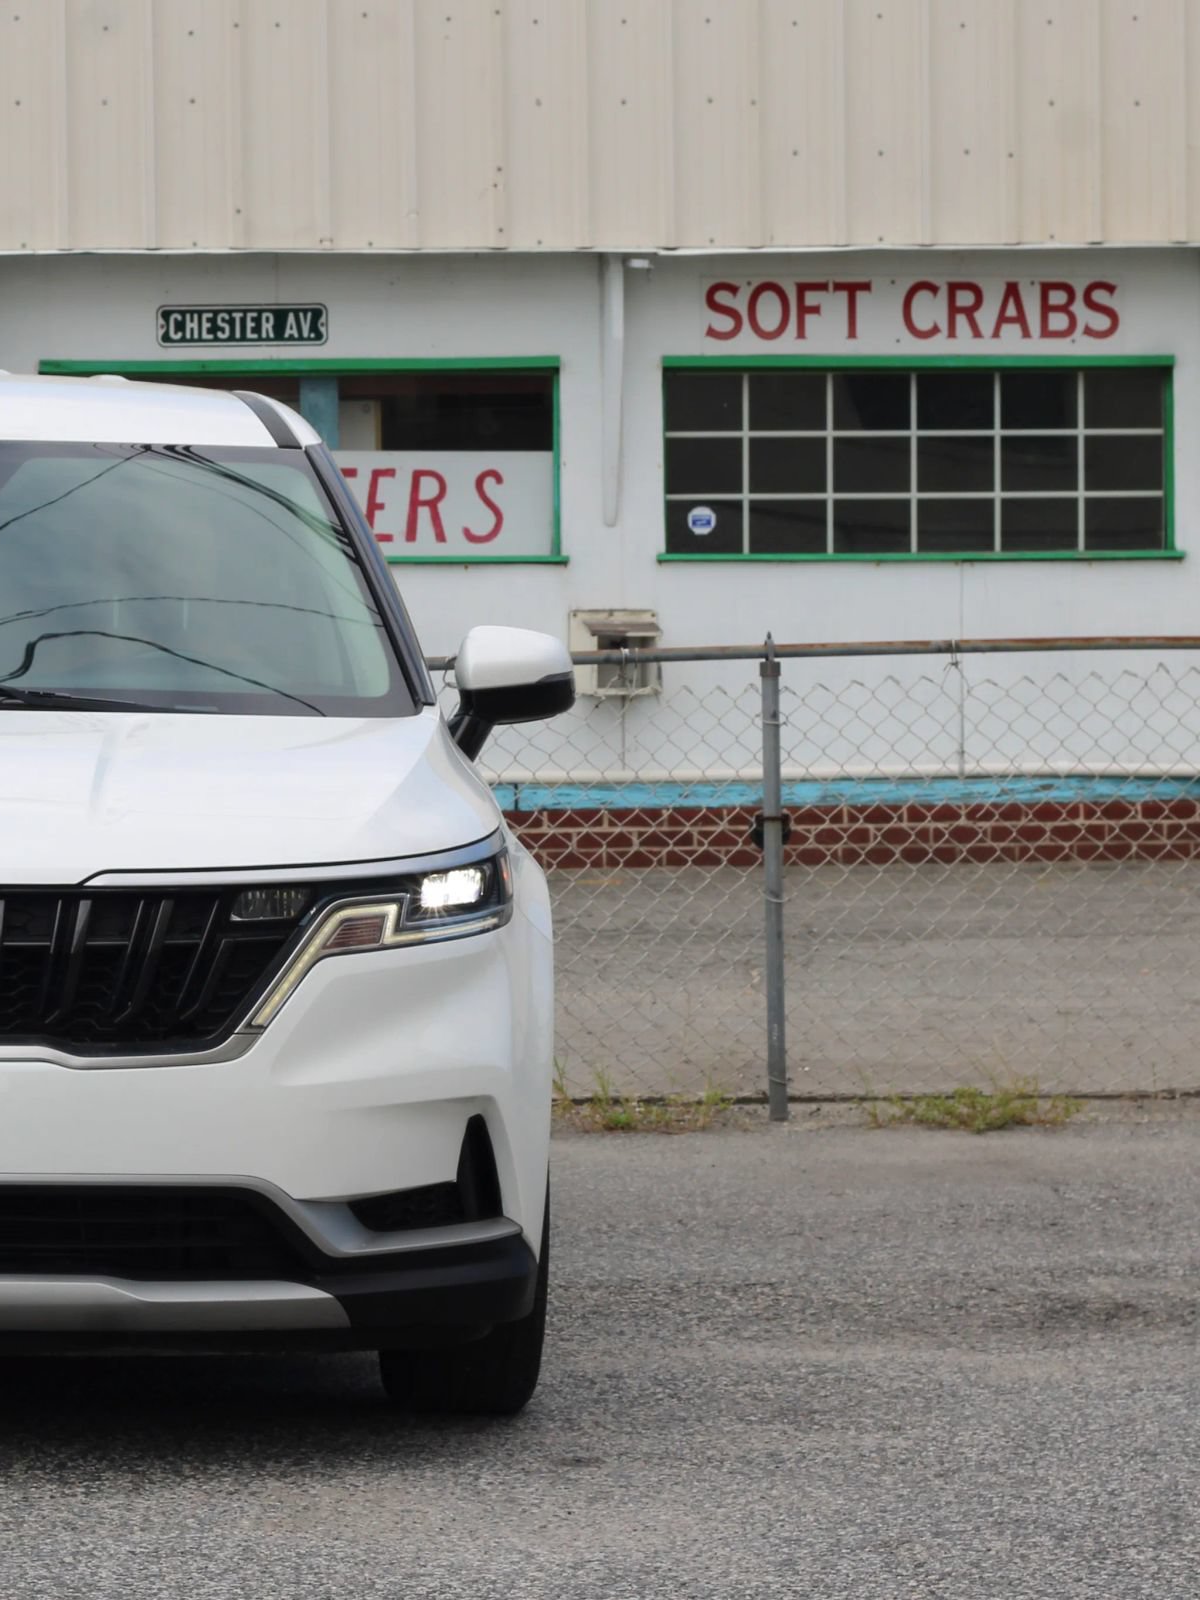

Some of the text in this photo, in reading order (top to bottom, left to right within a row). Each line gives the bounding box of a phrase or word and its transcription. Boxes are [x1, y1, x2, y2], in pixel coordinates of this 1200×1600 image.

[168, 311, 316, 340] CHESTER AV.
[704, 280, 1121, 341] SOFT CRABS
